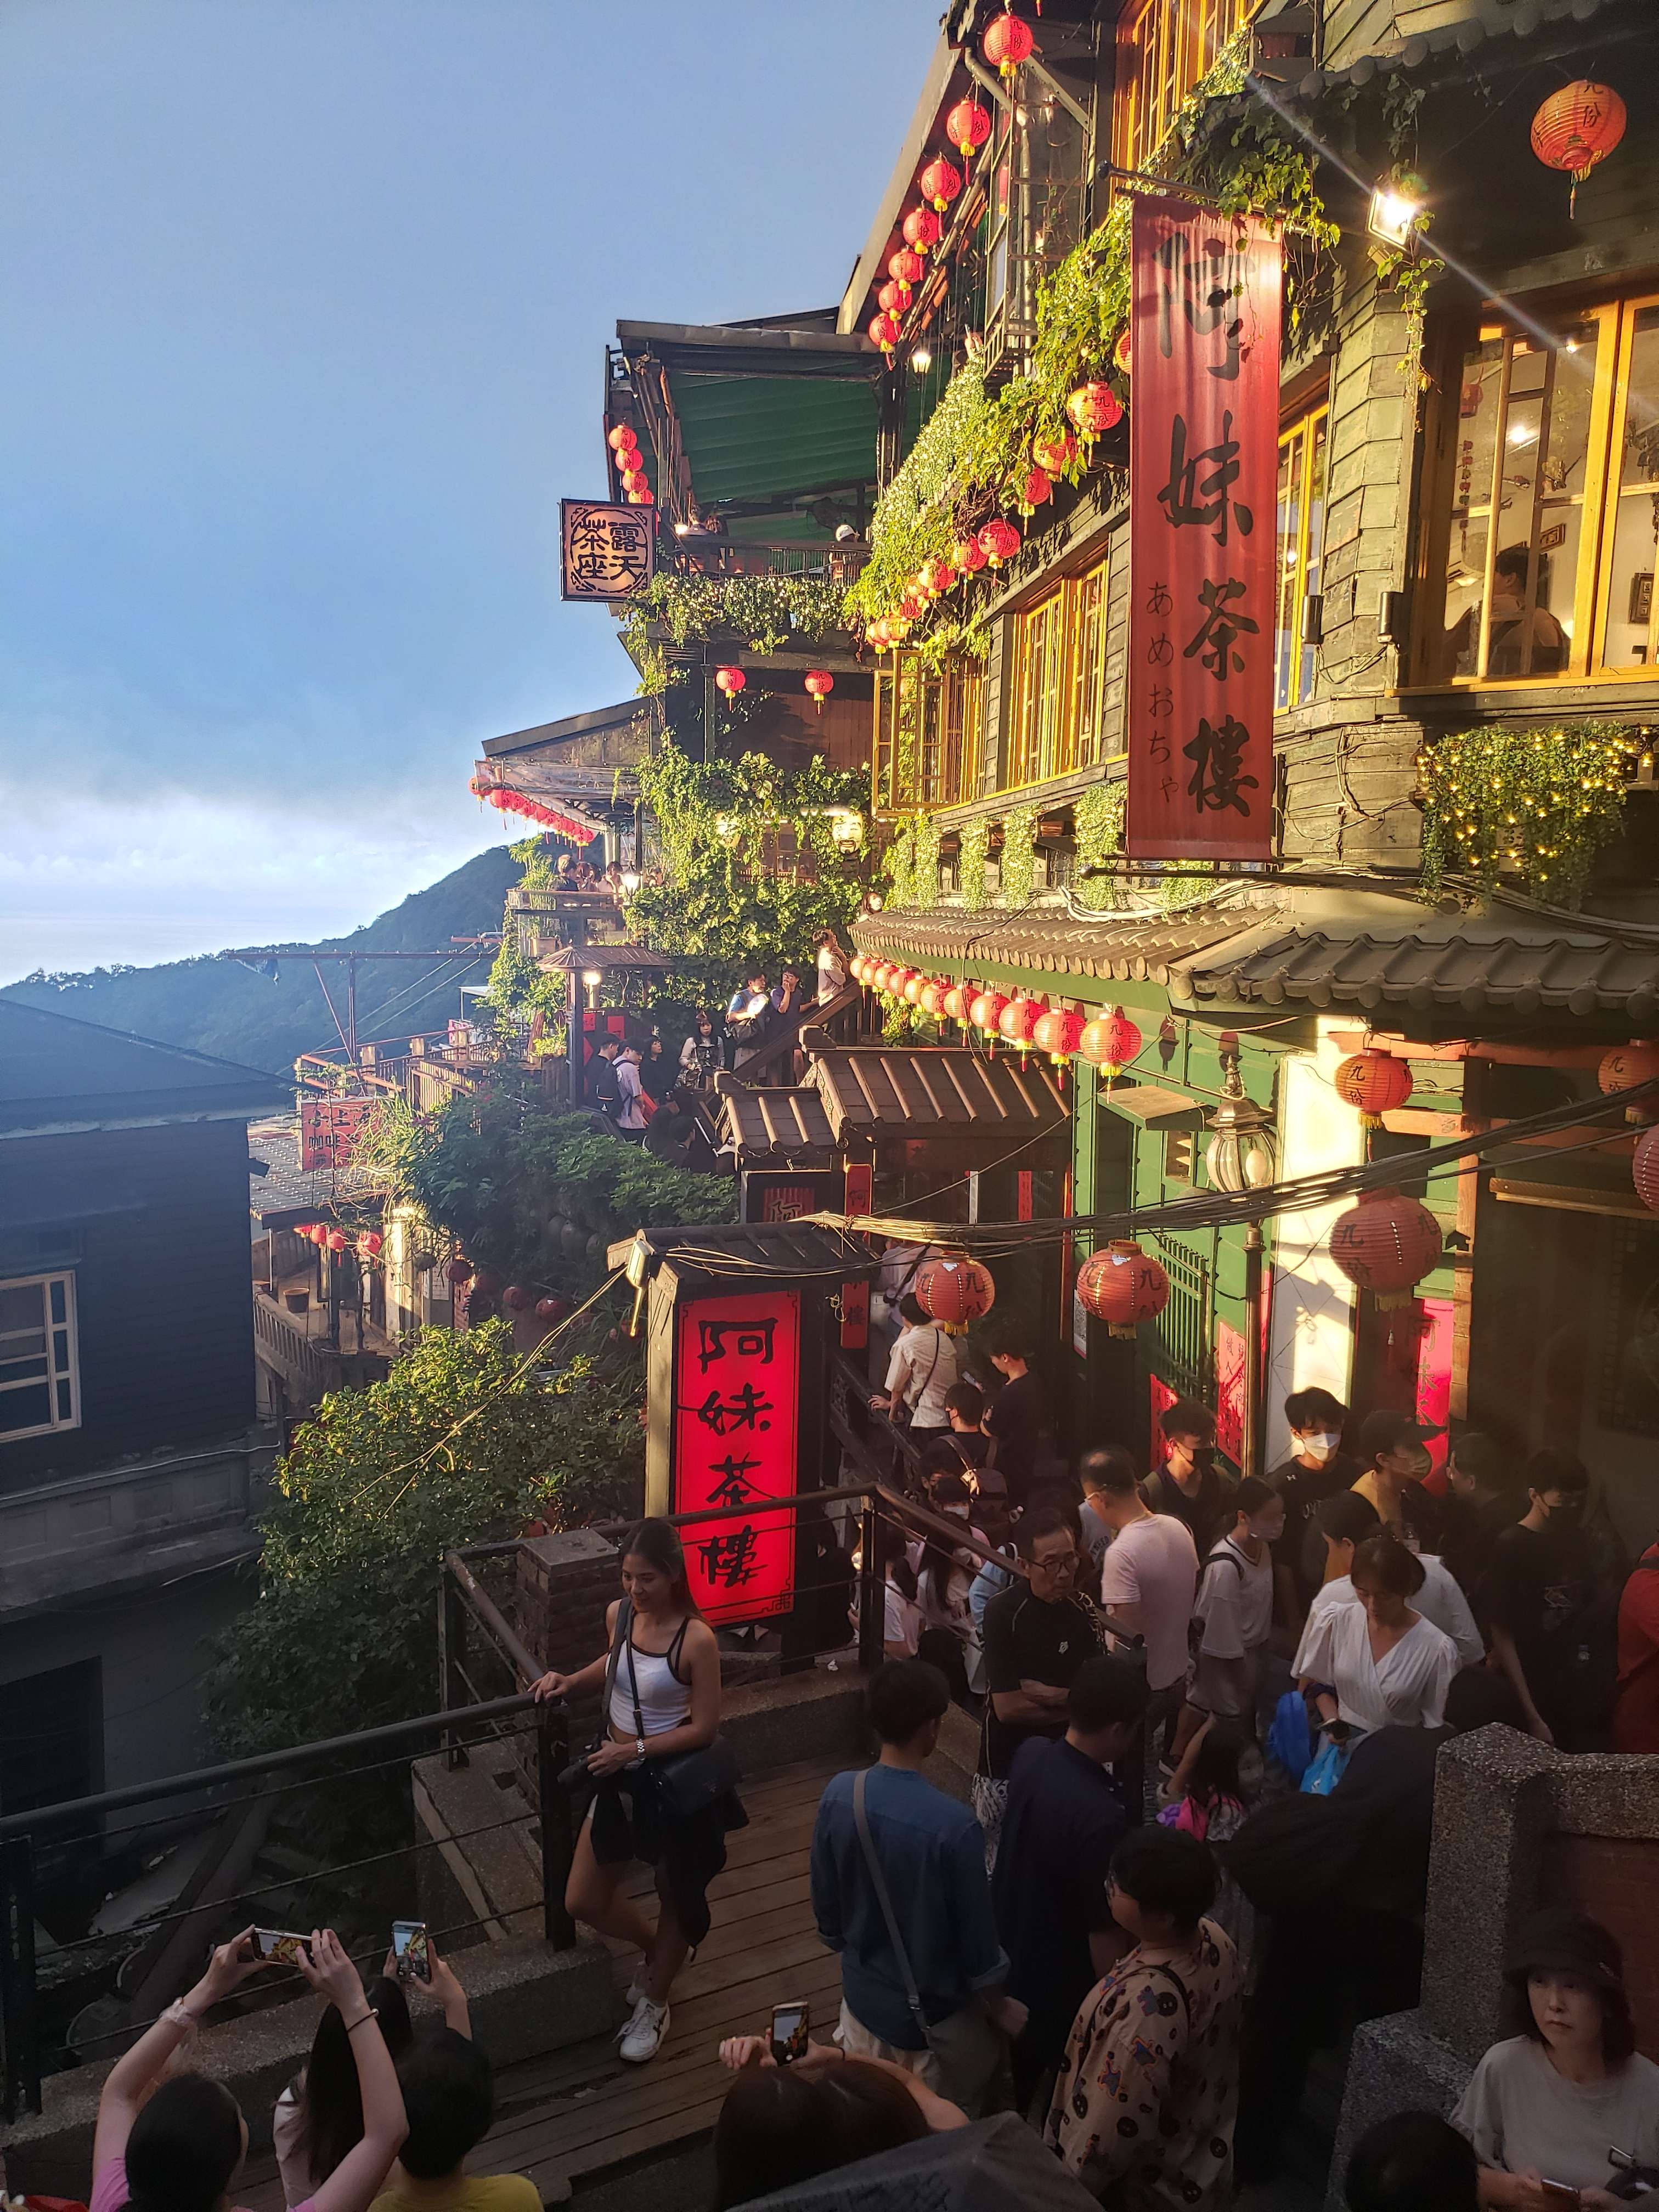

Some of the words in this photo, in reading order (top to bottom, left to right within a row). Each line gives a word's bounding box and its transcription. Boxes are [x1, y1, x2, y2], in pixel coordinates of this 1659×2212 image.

[1153, 232, 1260, 817] 阿妹茶樓
[1146, 581, 1179, 803] あめおちゃ
[1061, 1021, 1073, 1051] 九份
[1110, 1024, 1123, 1057] 九份
[1350, 1065, 1365, 1105] 九份
[697, 1317, 779, 1588] 阿妹茶樓
